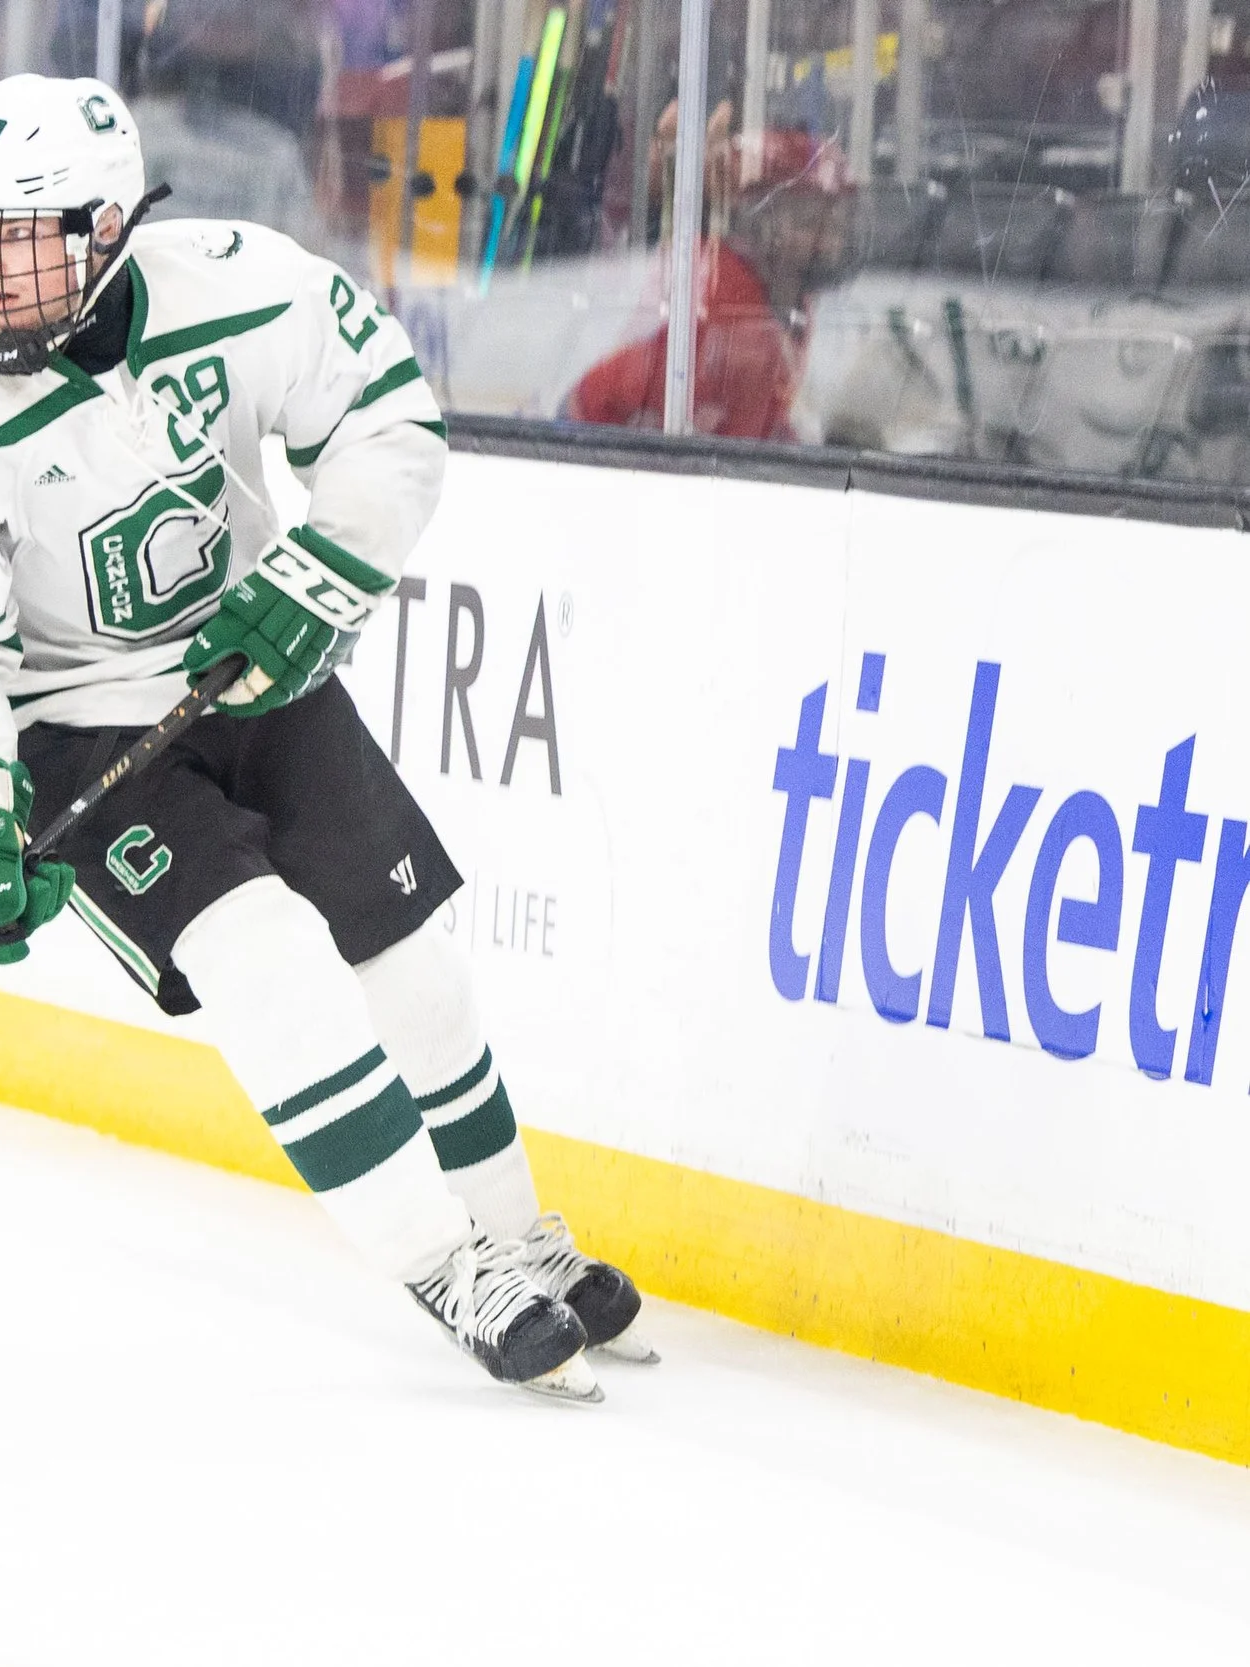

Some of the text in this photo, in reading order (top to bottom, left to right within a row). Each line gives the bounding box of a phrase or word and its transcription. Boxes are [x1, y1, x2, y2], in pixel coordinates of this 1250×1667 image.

[330, 274, 391, 354] 2
[151, 356, 230, 463] 29
[102, 534, 134, 624] CANTON
[262, 544, 372, 626] CC
[342, 575, 562, 797] TRA
[493, 884, 557, 957] LIFE
